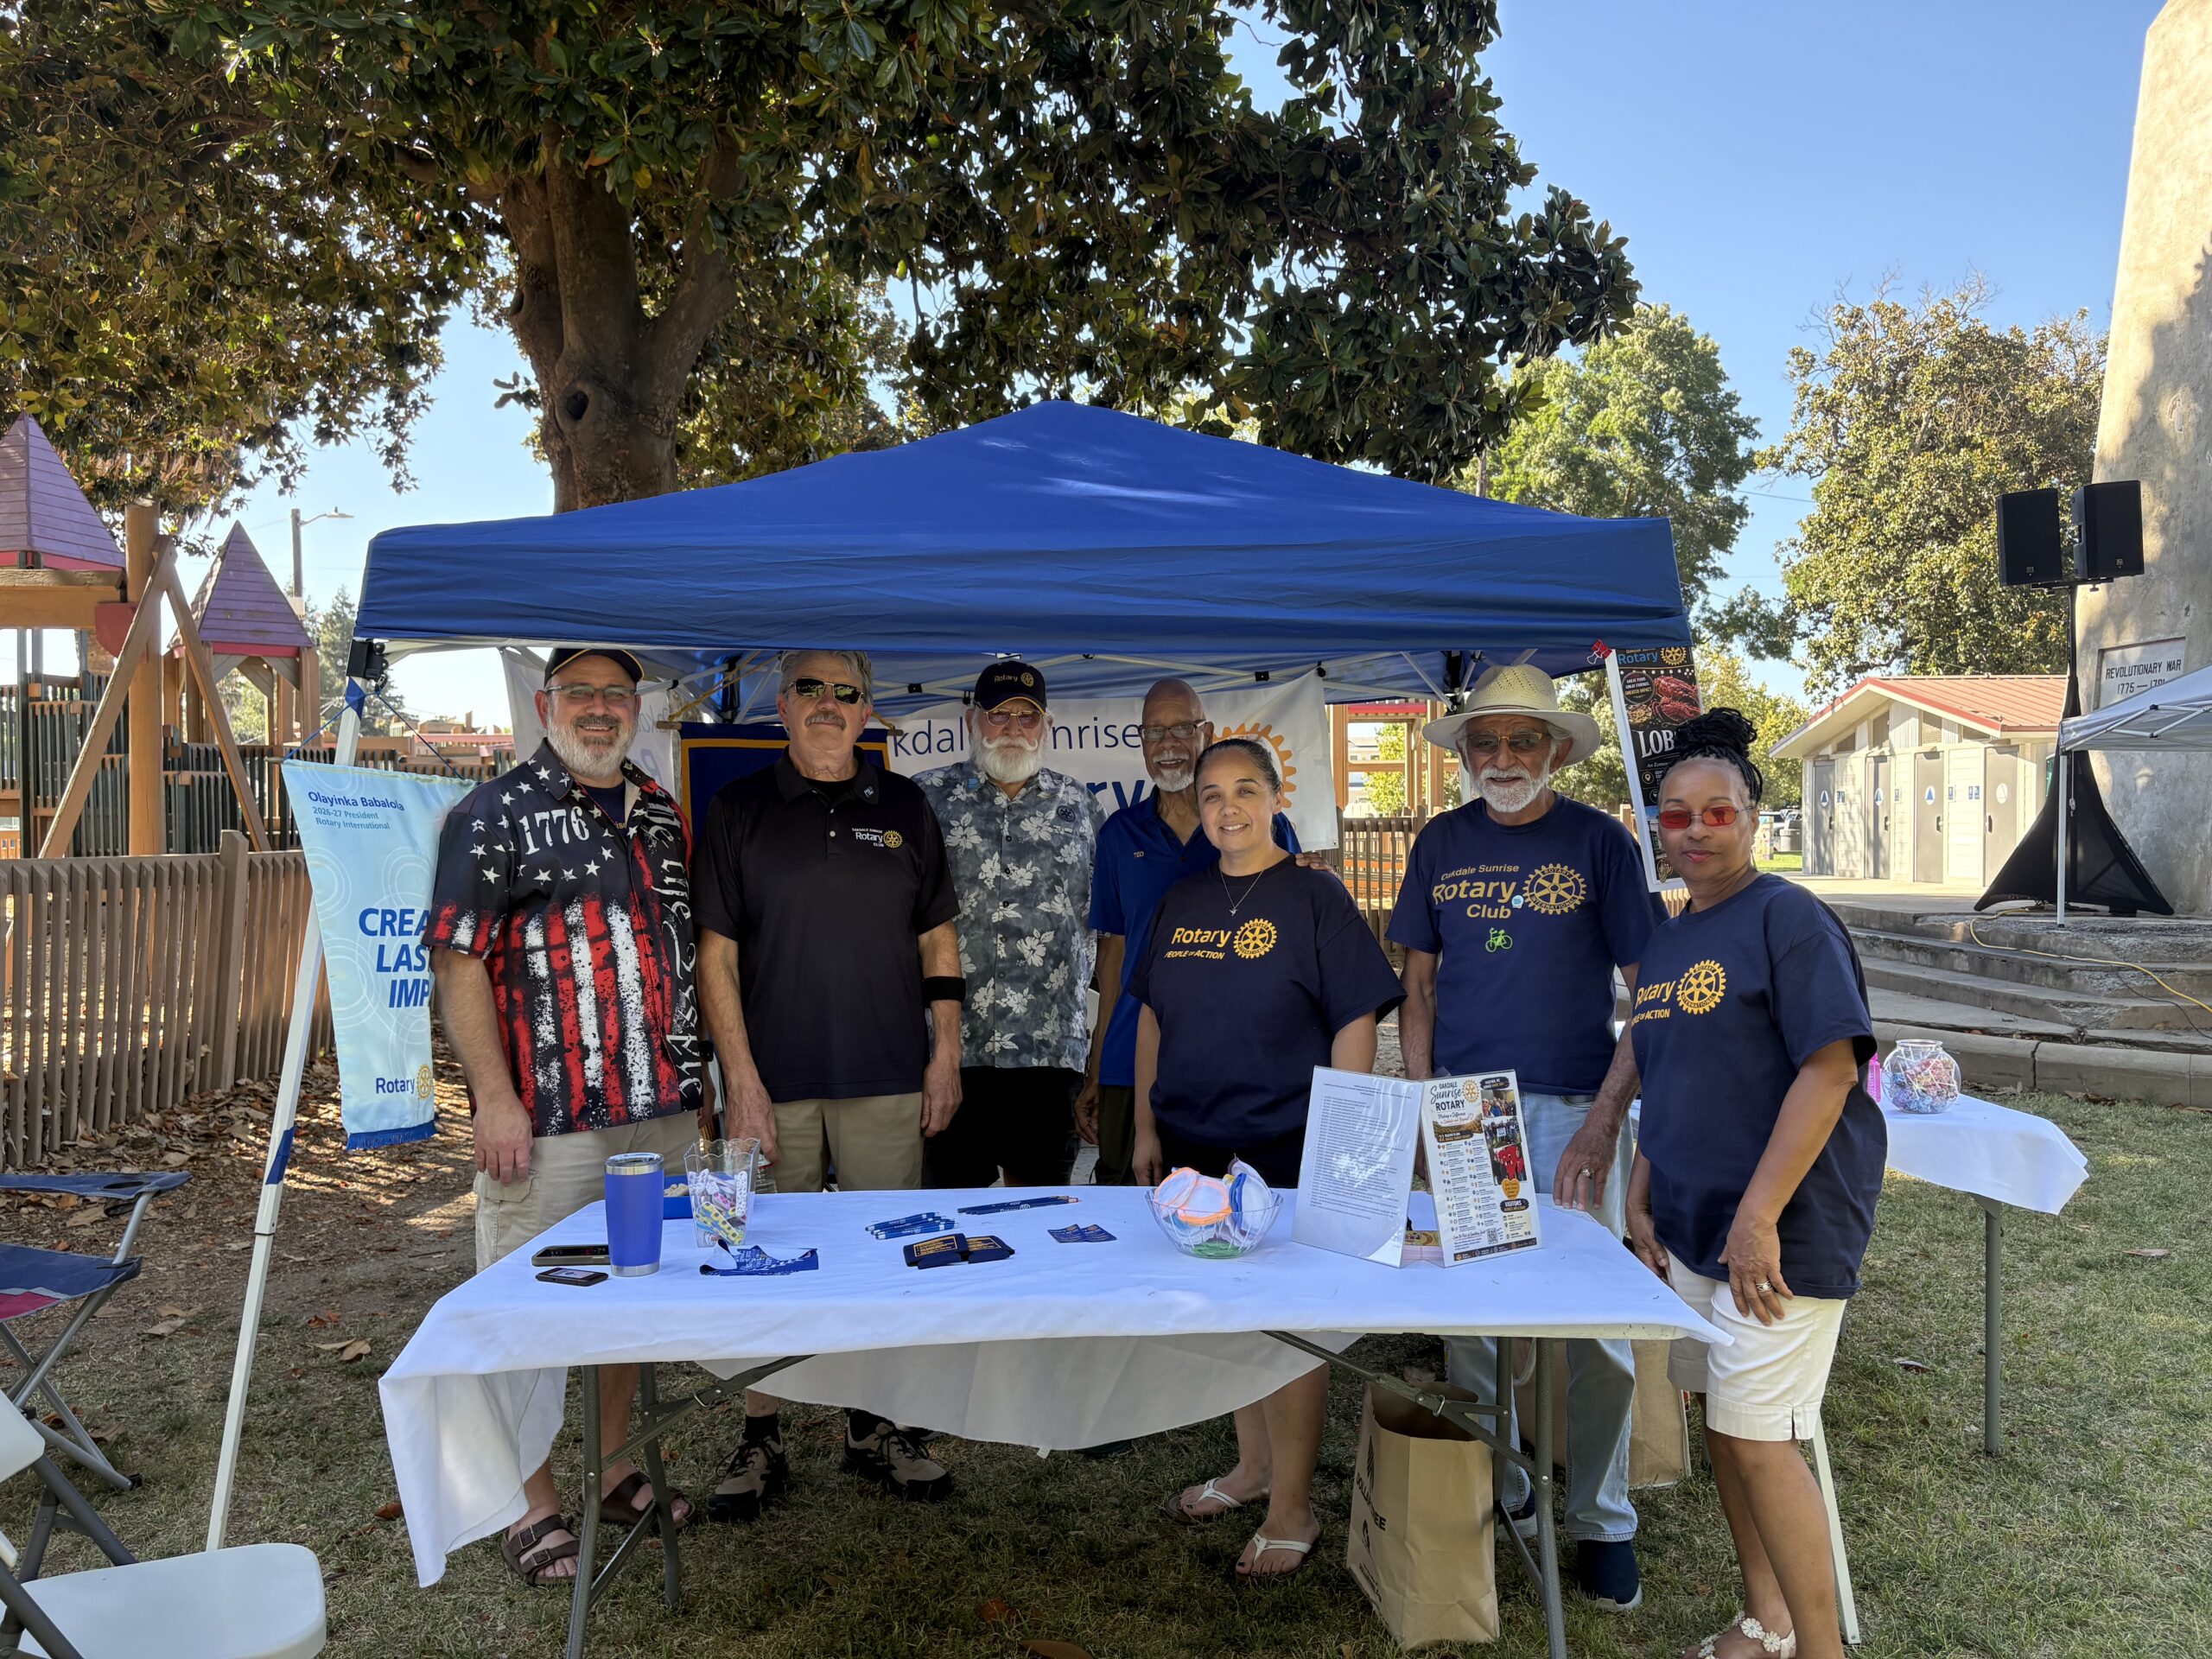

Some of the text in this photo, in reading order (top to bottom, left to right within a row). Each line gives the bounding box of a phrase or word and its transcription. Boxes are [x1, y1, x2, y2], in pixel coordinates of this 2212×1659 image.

[1618, 652, 1658, 664] Rotary
[2106, 659, 2181, 679] REVOLUTIONARY WAR
[995, 674, 1018, 683] Rotary
[2118, 683, 2135, 694] 1775
[1637, 729, 1675, 759] LOB
[308, 791, 404, 811] Olayinka Babalola
[312, 806, 379, 820] 2026-27 President
[315, 817, 390, 830] Rotary International
[518, 806, 590, 855] 1776
[855, 831, 882, 842] Rotary
[1440, 863, 1520, 881] Oakdale Sunrise
[1432, 880, 1516, 906] Rotary
[1531, 894, 1577, 909] INTERNATIONAL
[1466, 904, 1512, 919] Club
[1171, 927, 1232, 948] Rotary
[377, 944, 429, 972] LAS
[1194, 950, 1225, 960] ACTION
[1635, 981, 1676, 1010] Rotary
[1645, 1007, 1670, 1020] ACTION
[376, 1077, 415, 1094] Rotary
[1430, 1085, 1462, 1104] Sunrise
[1435, 1099, 1465, 1111] ROTARY
